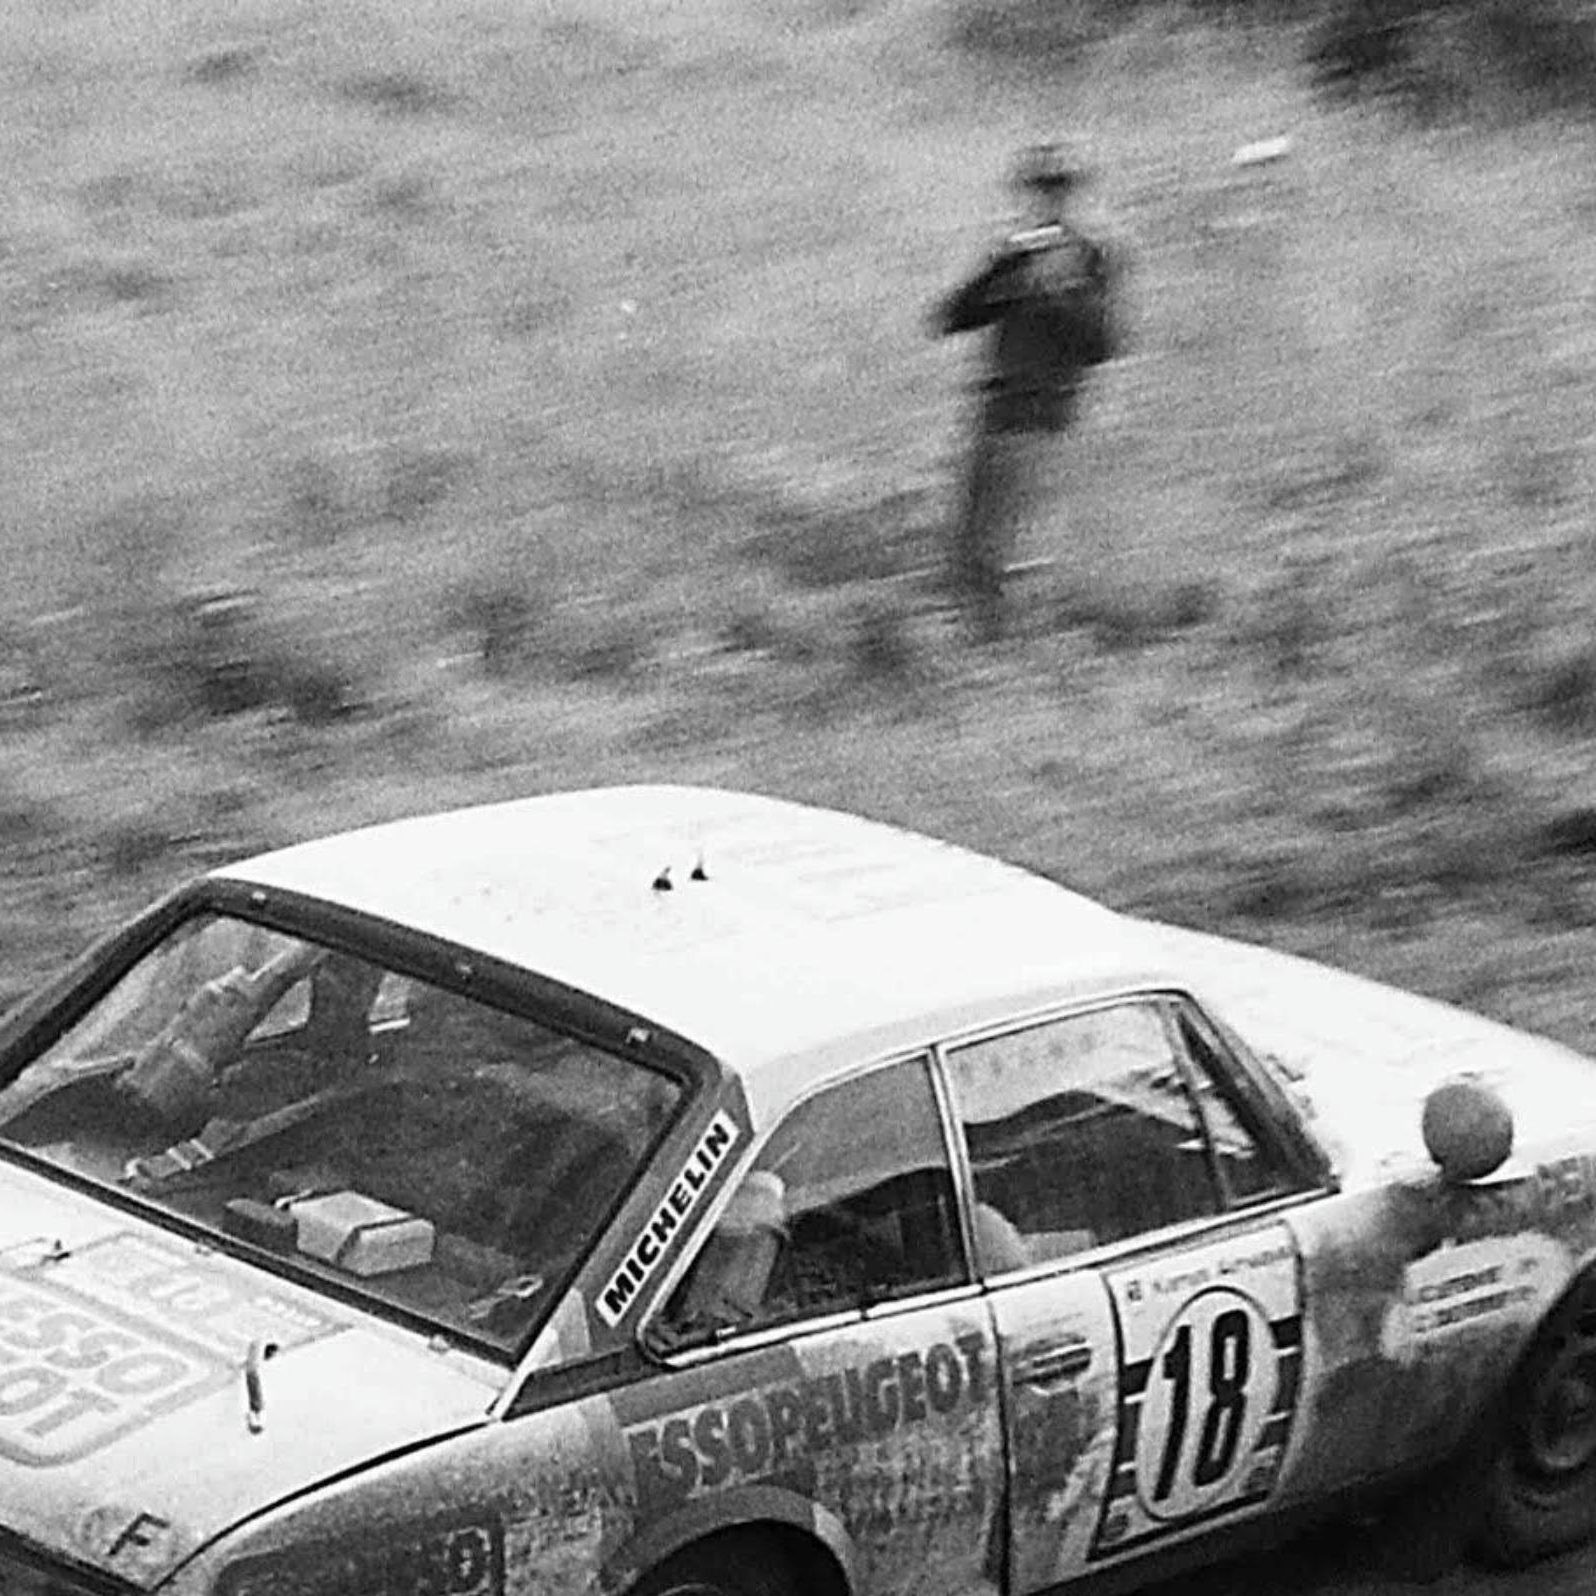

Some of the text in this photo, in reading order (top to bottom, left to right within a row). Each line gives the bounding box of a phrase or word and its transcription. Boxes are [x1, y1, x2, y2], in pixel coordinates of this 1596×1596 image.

[603, 1122, 730, 1315] MICHELIN
[1154, 1309, 1250, 1502] 18
[107, 1512, 171, 1557] F
